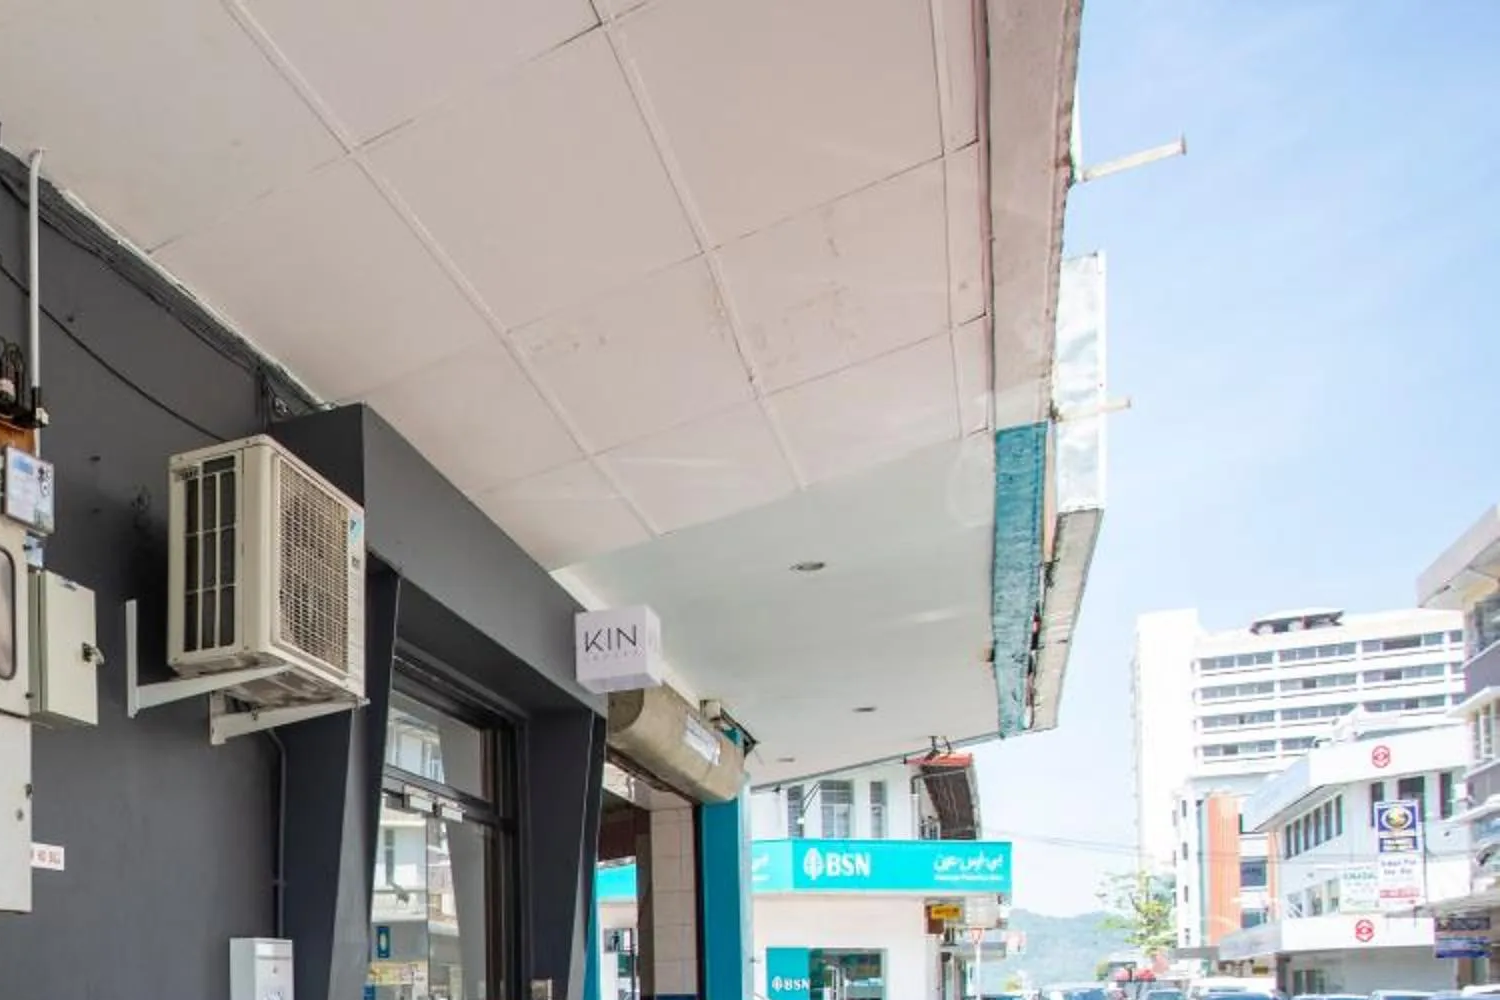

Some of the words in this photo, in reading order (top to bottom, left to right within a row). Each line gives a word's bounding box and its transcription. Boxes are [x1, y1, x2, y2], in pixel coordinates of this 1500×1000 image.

[584, 623, 637, 653] KIN
[826, 852, 872, 877] BSN
[783, 977, 811, 991] BSN
